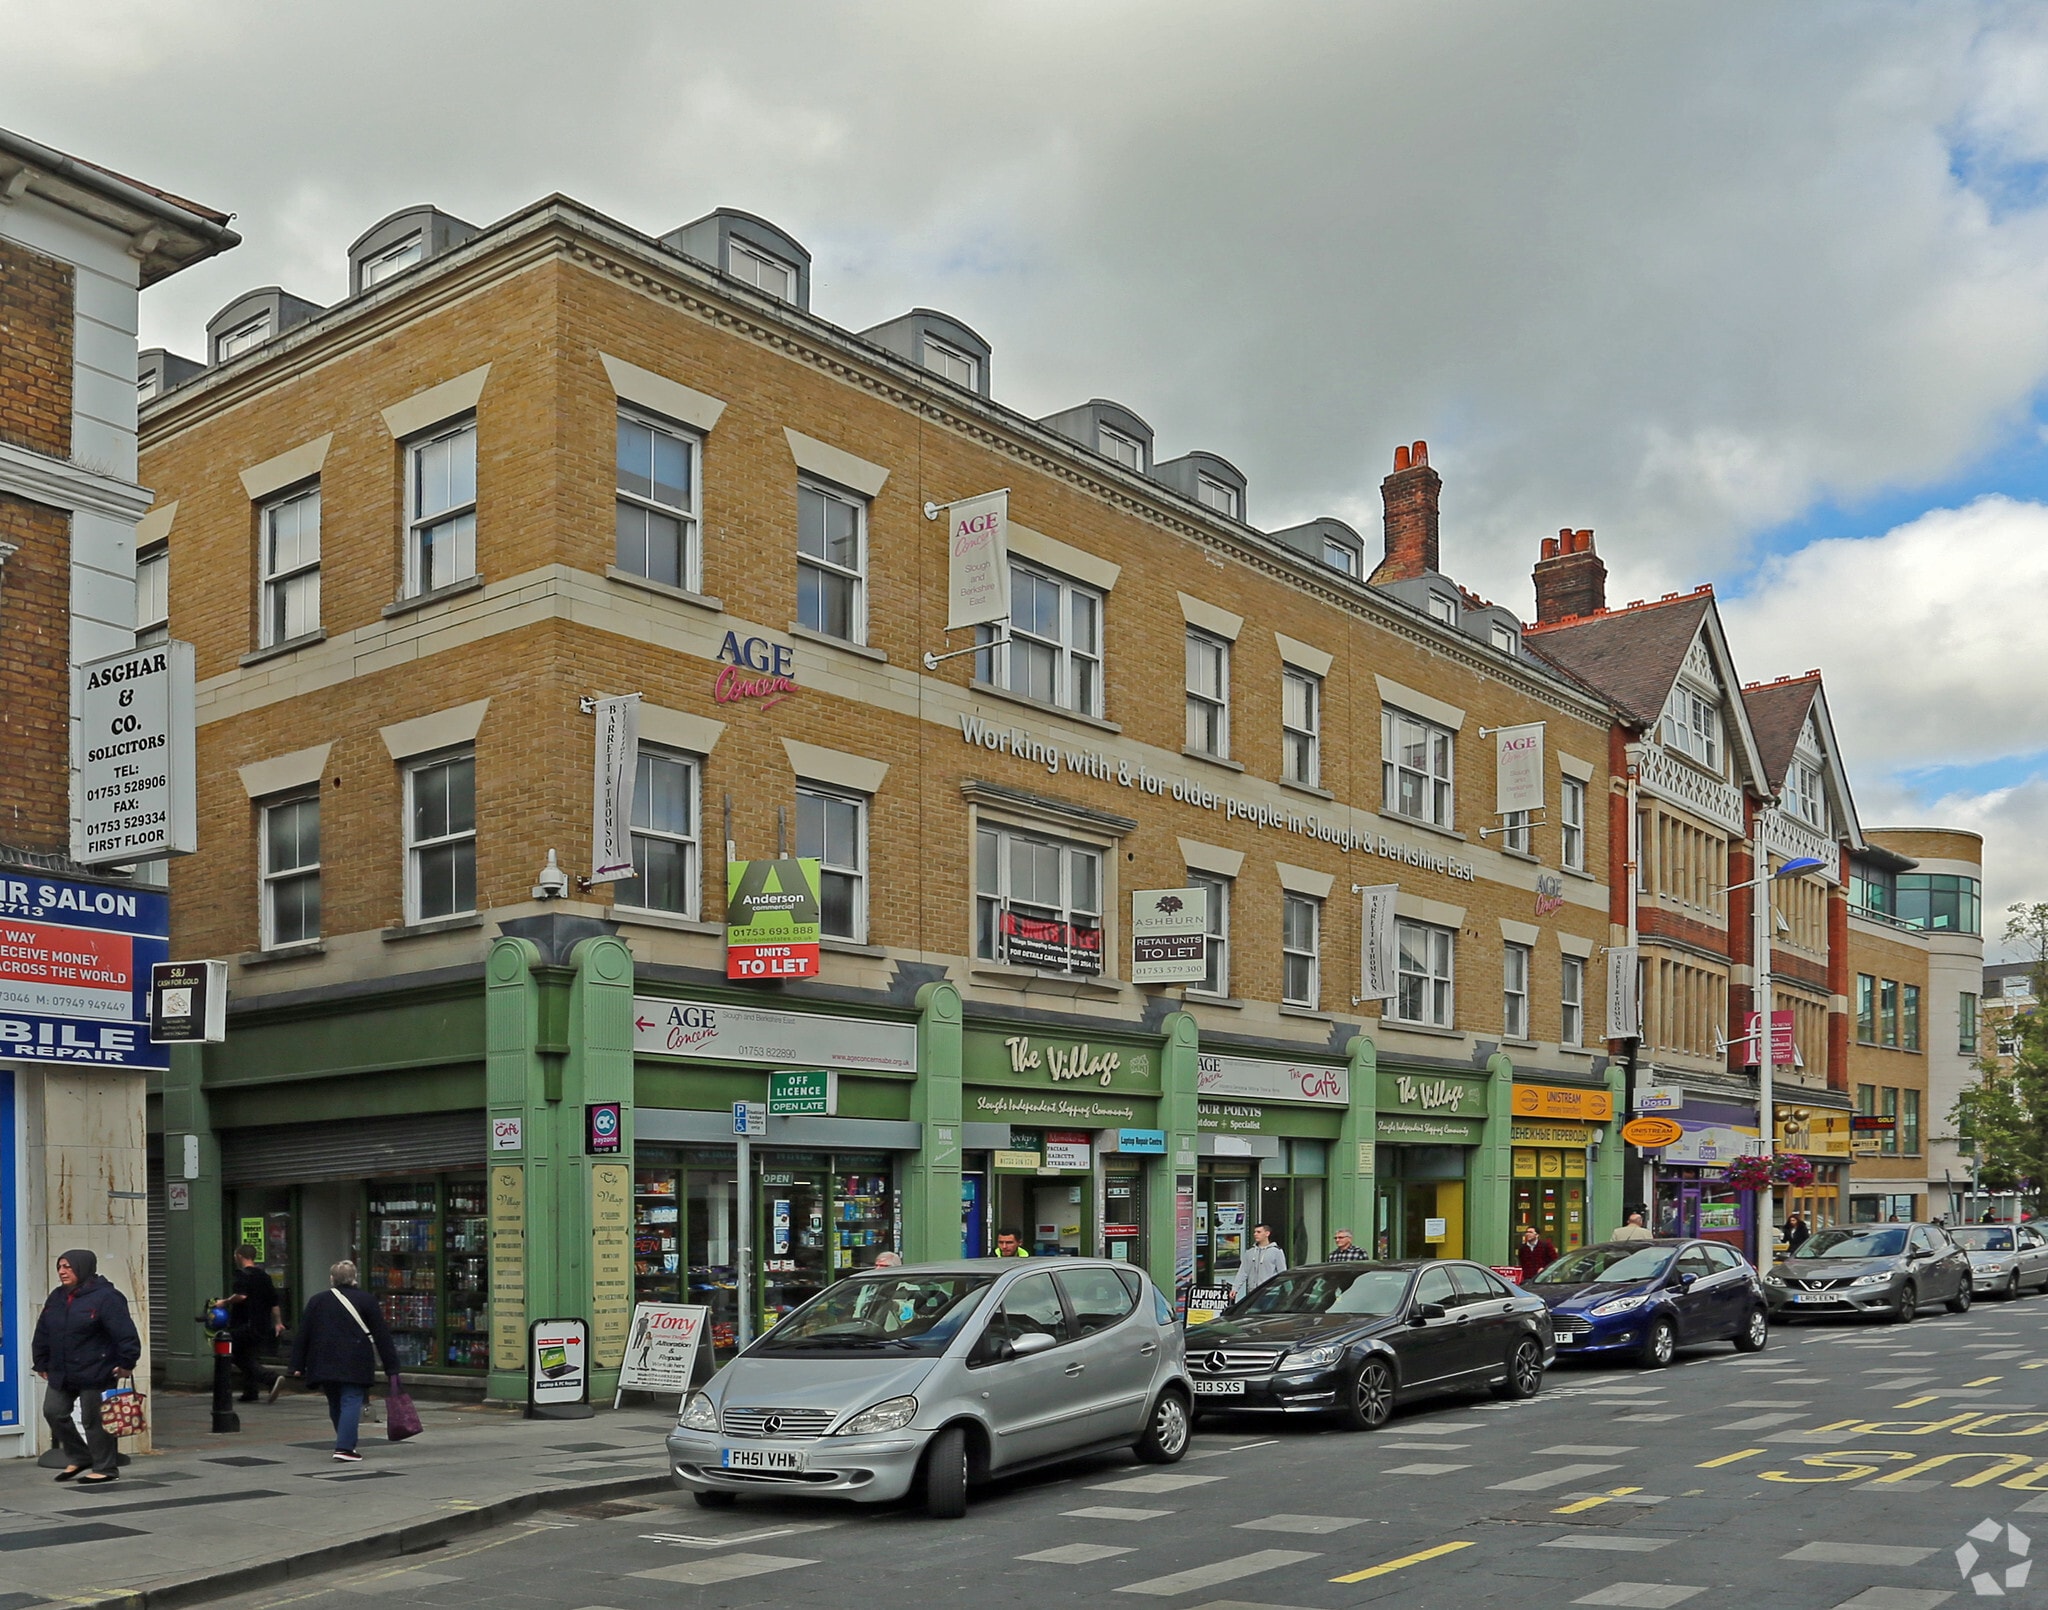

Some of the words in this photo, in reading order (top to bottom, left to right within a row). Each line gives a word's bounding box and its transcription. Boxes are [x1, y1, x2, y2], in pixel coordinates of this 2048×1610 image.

[955, 512, 999, 537] AGE
[954, 528, 999, 557] Concern
[964, 561, 991, 573] Slough
[971, 573, 985, 583] and
[960, 583, 995, 597] Berkshire
[969, 596, 986, 606] East
[716, 630, 795, 679] AGE
[86, 653, 167, 691] ASGHAR
[715, 666, 800, 703] Concern
[118, 688, 134, 706] &
[111, 715, 142, 735] CO.
[605, 705, 617, 772] BARRETT
[1502, 736, 1537, 752] AGE
[88, 734, 165, 762] SOLICITORS
[113, 764, 139, 778] TEL:
[87, 784, 121, 801] 01753
[124, 775, 166, 795] 528906
[959, 712, 1060, 775] Working
[1065, 750, 1111, 782] with
[1117, 759, 1133, 789] &
[1138, 765, 1166, 796] for
[1172, 777, 1220, 811] older
[1226, 797, 1283, 831] people
[1287, 808, 1302, 834] in
[1306, 815, 1359, 853] Slough
[1363, 831, 1375, 854] &
[1378, 835, 1444, 873] Berkshire
[1447, 856, 1475, 882] East
[113, 799, 139, 813] FAX:
[87, 820, 121, 836] 01753
[124, 811, 166, 830] 529334
[605, 788, 613, 858] THOMSON
[88, 837, 122, 853] FIRST
[125, 829, 165, 847] FLOOR
[1536, 874, 1563, 898] AGE
[38, 885, 136, 918] SALON
[743, 894, 804, 905] Anderson
[752, 903, 794, 911] commercial
[1135, 916, 1203, 926] ASHBURN
[6, 930, 36, 944] WAY
[733, 928, 765, 937] 01753
[769, 927, 789, 936] 693
[1137, 938, 1170, 946] RETAIL
[1172, 936, 1201, 945] UNITS
[52, 951, 98, 967] MONEY
[755, 947, 791, 957] UNITS
[1022, 950, 1043, 960] DETAILS
[1044, 954, 1057, 962] CALL
[1142, 949, 1164, 959] TO
[1168, 947, 1197, 958] LET
[170, 968, 186, 978] S&J
[738, 960, 765, 975] TO
[771, 958, 808, 973] LET
[1136, 967, 1163, 975] 01753
[1167, 966, 1183, 974] 579
[1186, 965, 1202, 973] 300
[50, 966, 82, 980] THE
[80, 969, 126, 984] WORLD
[53, 996, 84, 1008] 07949
[88, 1001, 125, 1011] 949449
[667, 1007, 716, 1029] AGE
[722, 1011, 743, 1021] Slough
[744, 1013, 755, 1021] and
[756, 1013, 782, 1023] Berkshire
[783, 1016, 796, 1025] East
[667, 1027, 719, 1050] Concern
[15, 1045, 124, 1061] REPAIR
[738, 1046, 764, 1057] 01753
[766, 1047, 796, 1058] 822890
[1004, 1036, 1041, 1073] The
[1046, 1043, 1120, 1087] Village
[1198, 1057, 1221, 1072] AGE
[788, 1076, 808, 1085] OFF
[1288, 1068, 1300, 1080] The
[1301, 1070, 1341, 1097] Café
[776, 1087, 821, 1096] LICENCE
[1396, 1076, 1418, 1103] The
[1420, 1080, 1464, 1112] Village
[1547, 1091, 1582, 1104] UNISTREAM
[773, 1103, 798, 1111] OPEN
[800, 1102, 824, 1110] LATE
[1008, 1099, 1056, 1114] Independent
[1058, 1101, 1090, 1118] Shopping
[1091, 1103, 1134, 1120] Community
[1643, 1099, 1669, 1107] Dosa
[737, 1105, 744, 1116] P
[1224, 1105, 1261, 1118] POINTS
[1230, 1120, 1261, 1130] Specialist
[593, 1137, 617, 1145] payzone
[1511, 1127, 1551, 1141] ДЕНЕЖНЫЕ
[1552, 1128, 1589, 1142] ПЕРЕВОДЫ
[763, 1174, 789, 1183] OPEN
[1192, 1289, 1221, 1299] LAPTOPS
[1223, 1290, 1228, 1299] &
[651, 1312, 696, 1336] Tony
[655, 1340, 691, 1348] Alteration
[1556, 1333, 1568, 1341] TF
[1216, 1382, 1240, 1392] SXS
[733, 1451, 763, 1466] FH51
